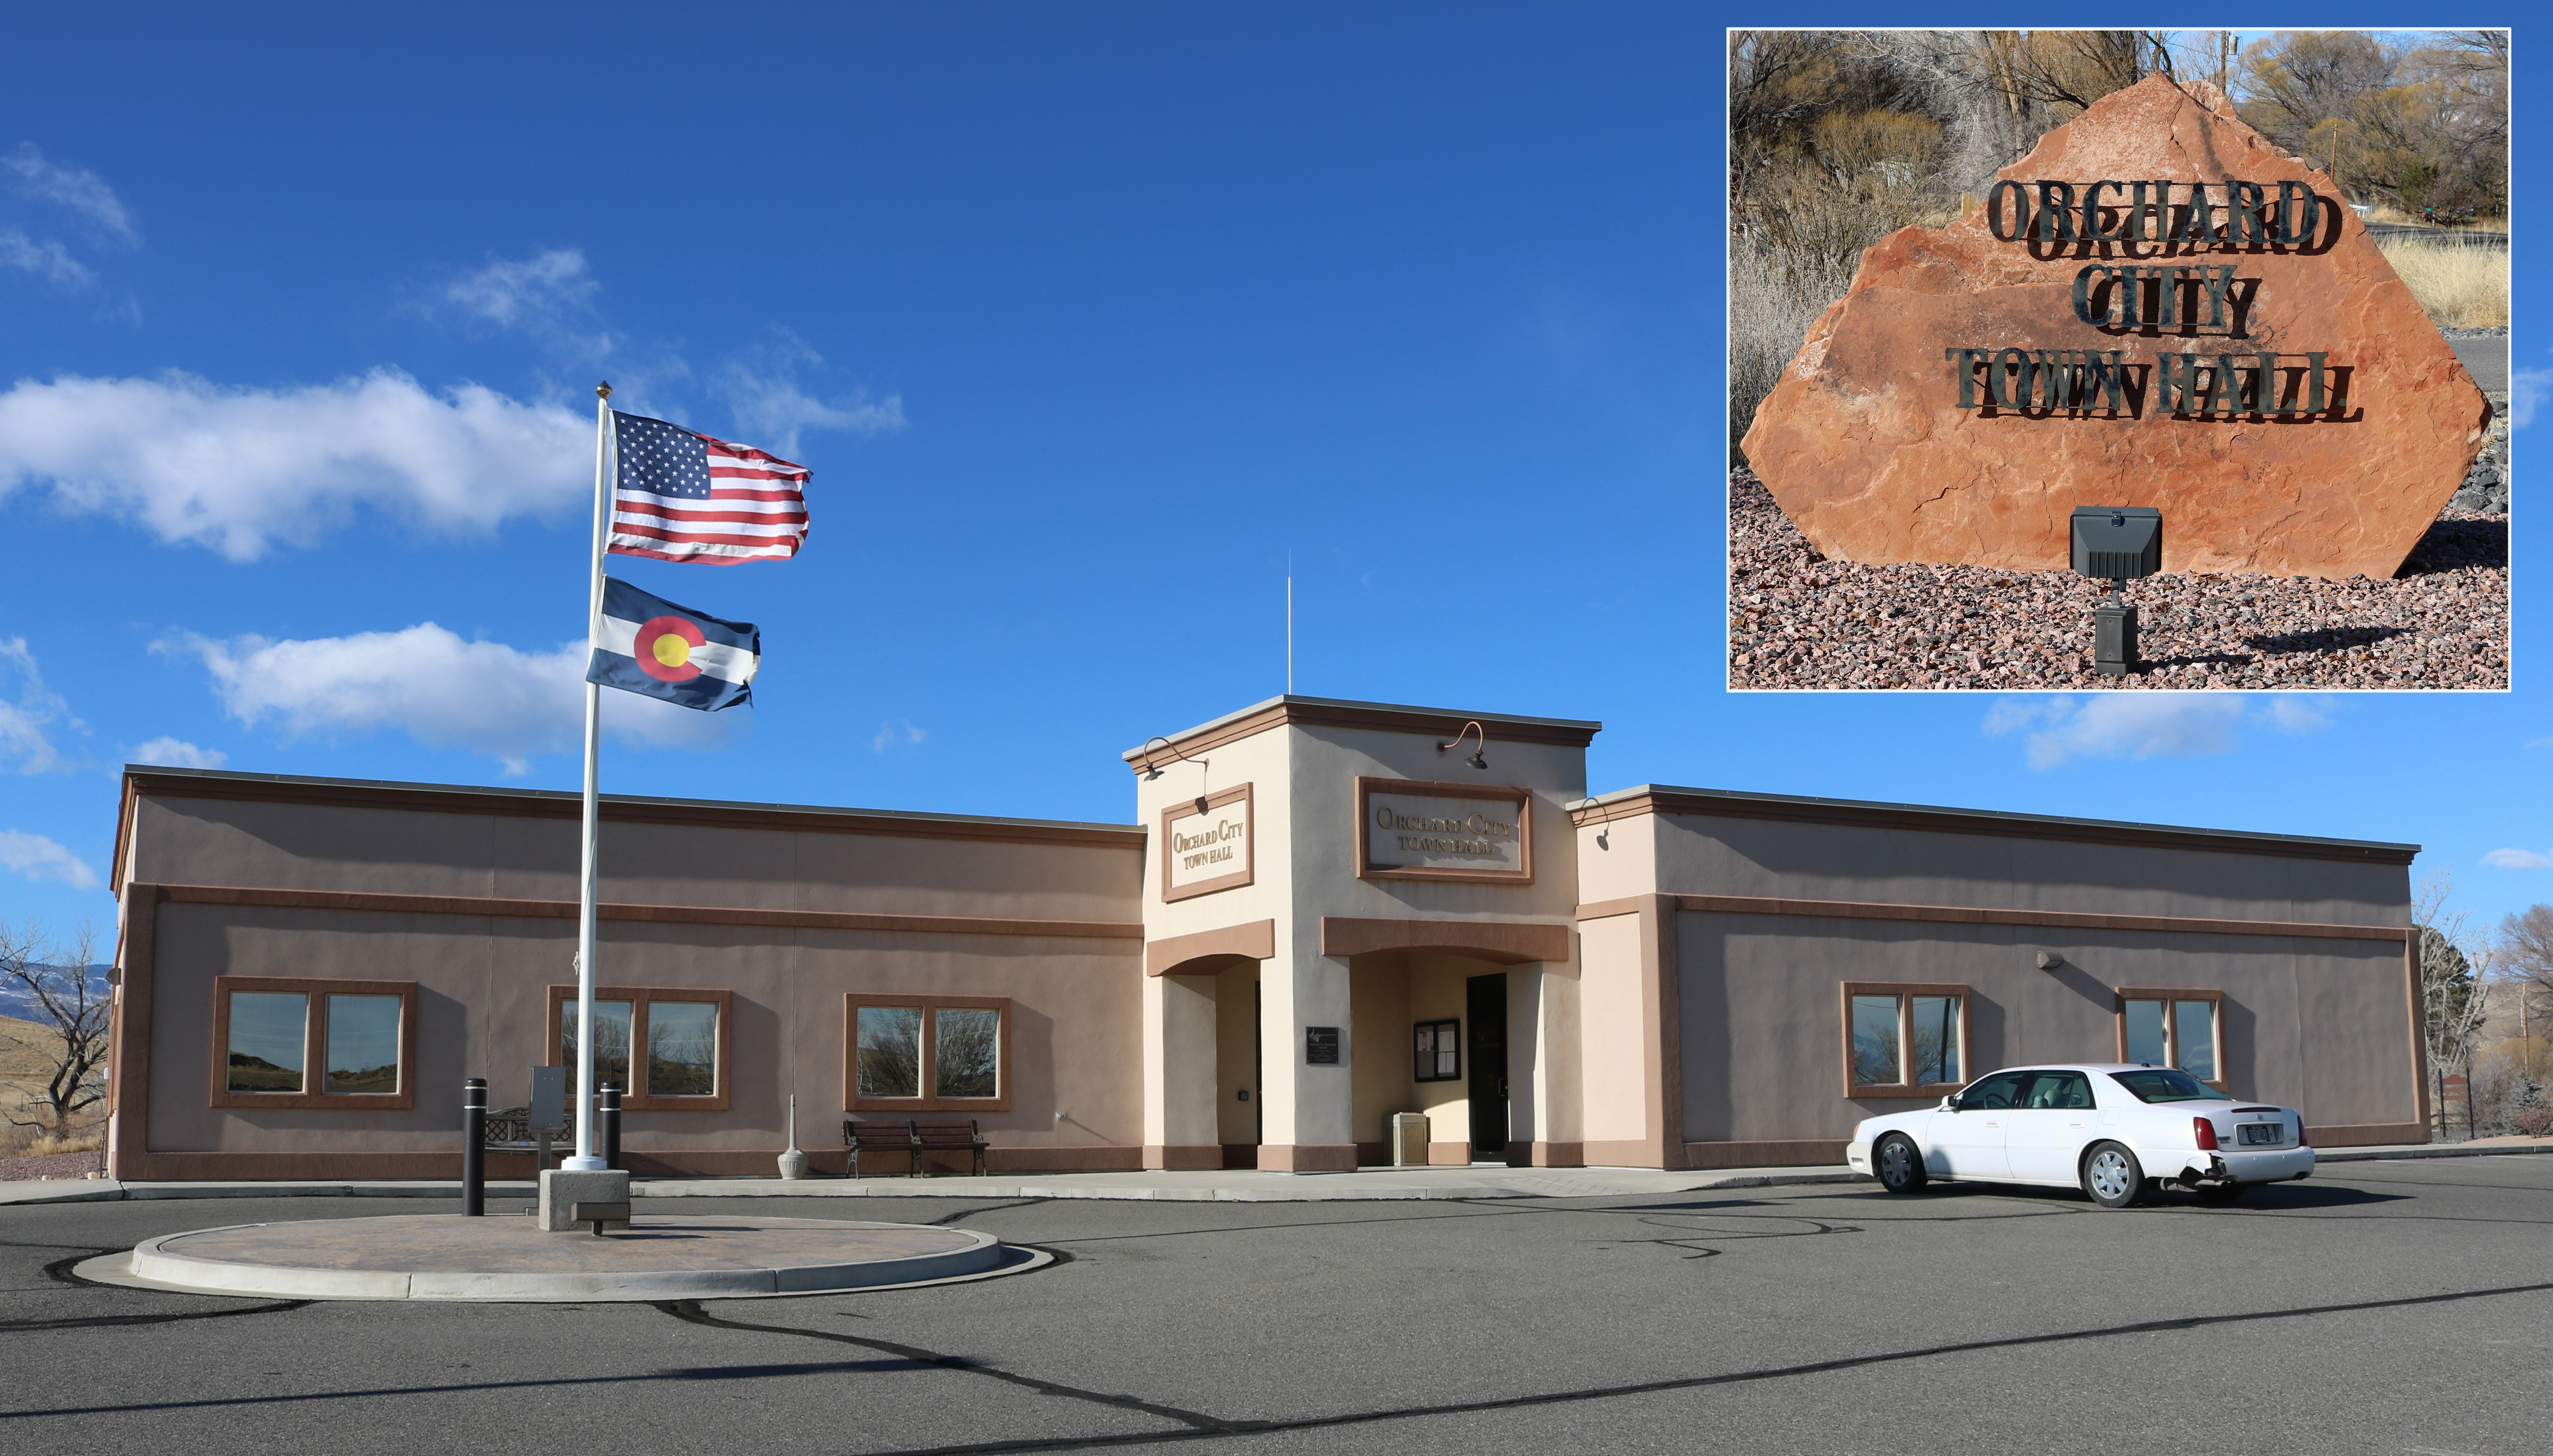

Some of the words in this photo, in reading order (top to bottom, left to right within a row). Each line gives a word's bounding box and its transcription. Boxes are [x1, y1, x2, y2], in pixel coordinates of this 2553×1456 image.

[1988, 179, 2319, 243] ORCHARD
[2072, 264, 2238, 328] CITY
[1945, 347, 2124, 411] TOWN
[2156, 351, 2346, 415] HALL
[1174, 830, 1218, 853] ORCHARD
[1218, 819, 1244, 841] CITY
[1377, 807, 1464, 833] ORCHARD
[1468, 813, 1511, 836] CITY
[1183, 851, 1209, 870] TOWN
[1210, 846, 1233, 863] HALL
[1398, 836, 1446, 852] TOWN
[1451, 839, 1494, 855] HALL
